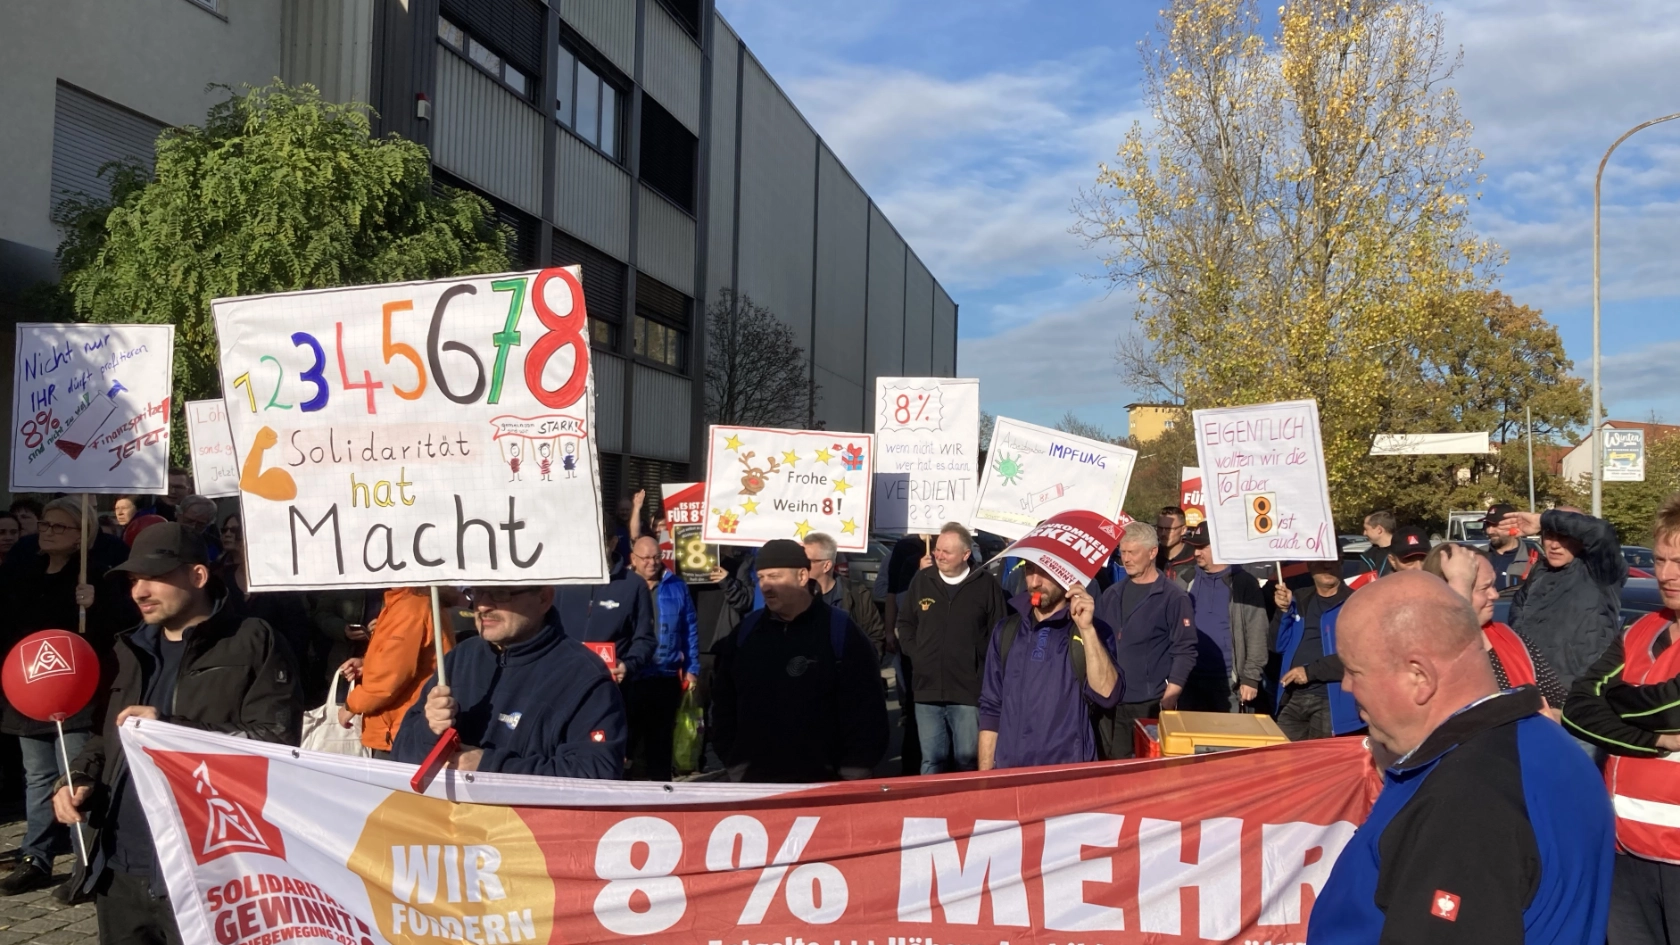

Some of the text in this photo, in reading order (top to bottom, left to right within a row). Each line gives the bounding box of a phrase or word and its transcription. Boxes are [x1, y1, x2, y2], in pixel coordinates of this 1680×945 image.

[25, 334, 110, 382] Nicht nur
[31, 384, 58, 412] IHR
[894, 393, 931, 425] 8%
[196, 404, 226, 424] Löh
[538, 420, 579, 434] STARK!
[20, 408, 60, 449] 8%
[1204, 416, 1305, 446] EIGENTLICH
[288, 427, 471, 467] Solidarität
[885, 441, 964, 455] wenn nicht WIR
[1048, 442, 1107, 469] IMPFUNG
[1260, 449, 1283, 466] wir
[1285, 447, 1308, 466] die
[211, 465, 235, 481] Jetzt
[787, 470, 828, 486] Frohe
[896, 458, 971, 472] wer hat es dann
[350, 467, 416, 508] hat
[884, 478, 971, 502] VERDIENT
[1240, 475, 1270, 492] aber
[667, 507, 689, 522] FÜR
[680, 502, 688, 510] ES
[1253, 496, 1297, 534] 8 ist
[287, 494, 544, 577] Macht
[1269, 532, 1301, 550] auch
[687, 540, 706, 569] 8
[391, 844, 507, 904] WIR
[897, 812, 1360, 942] MEHR
[207, 873, 345, 912] SOLIDARITÄ
